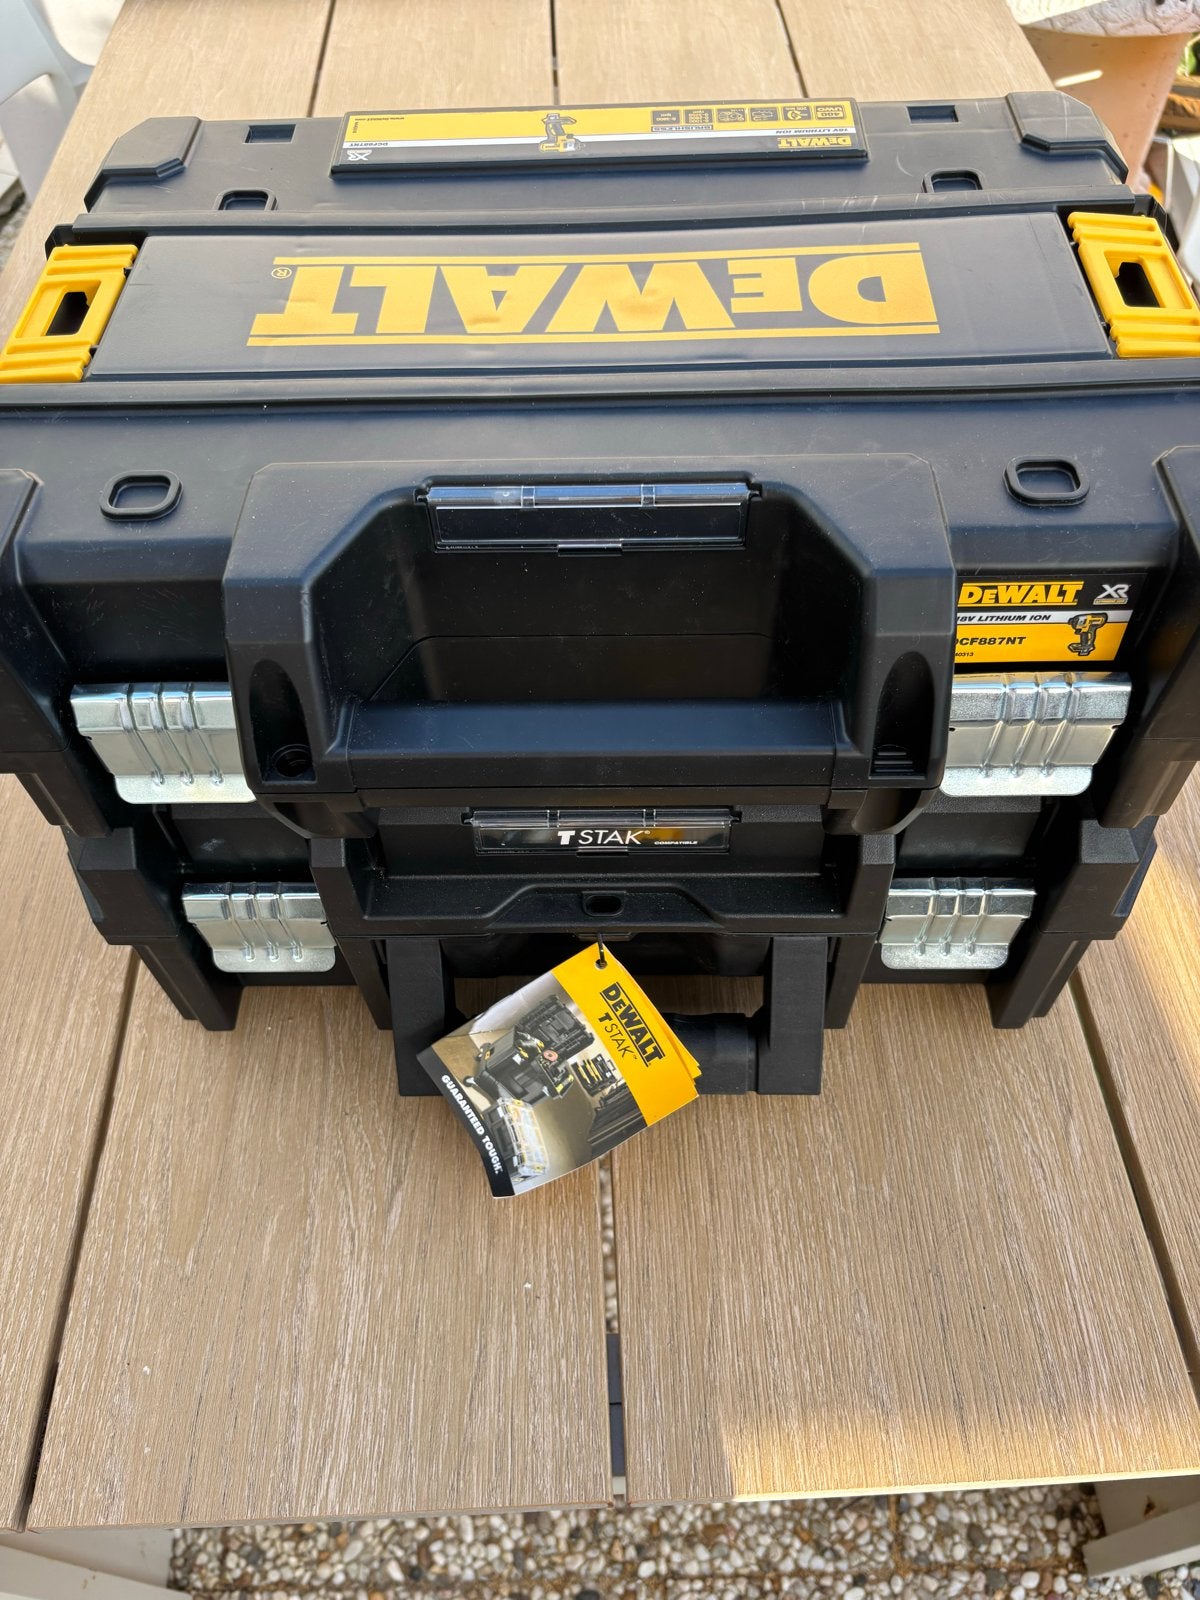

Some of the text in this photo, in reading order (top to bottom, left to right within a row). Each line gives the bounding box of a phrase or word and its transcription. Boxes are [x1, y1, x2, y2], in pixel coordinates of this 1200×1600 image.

[777, 136, 852, 148] DEWALT
[246, 242, 941, 347] DEWALT
[957, 581, 1085, 608] DEWALT
[1096, 584, 1130, 598] XR
[600, 982, 665, 1067] DEWALT
[441, 1074, 484, 1136] GUARANTEED
